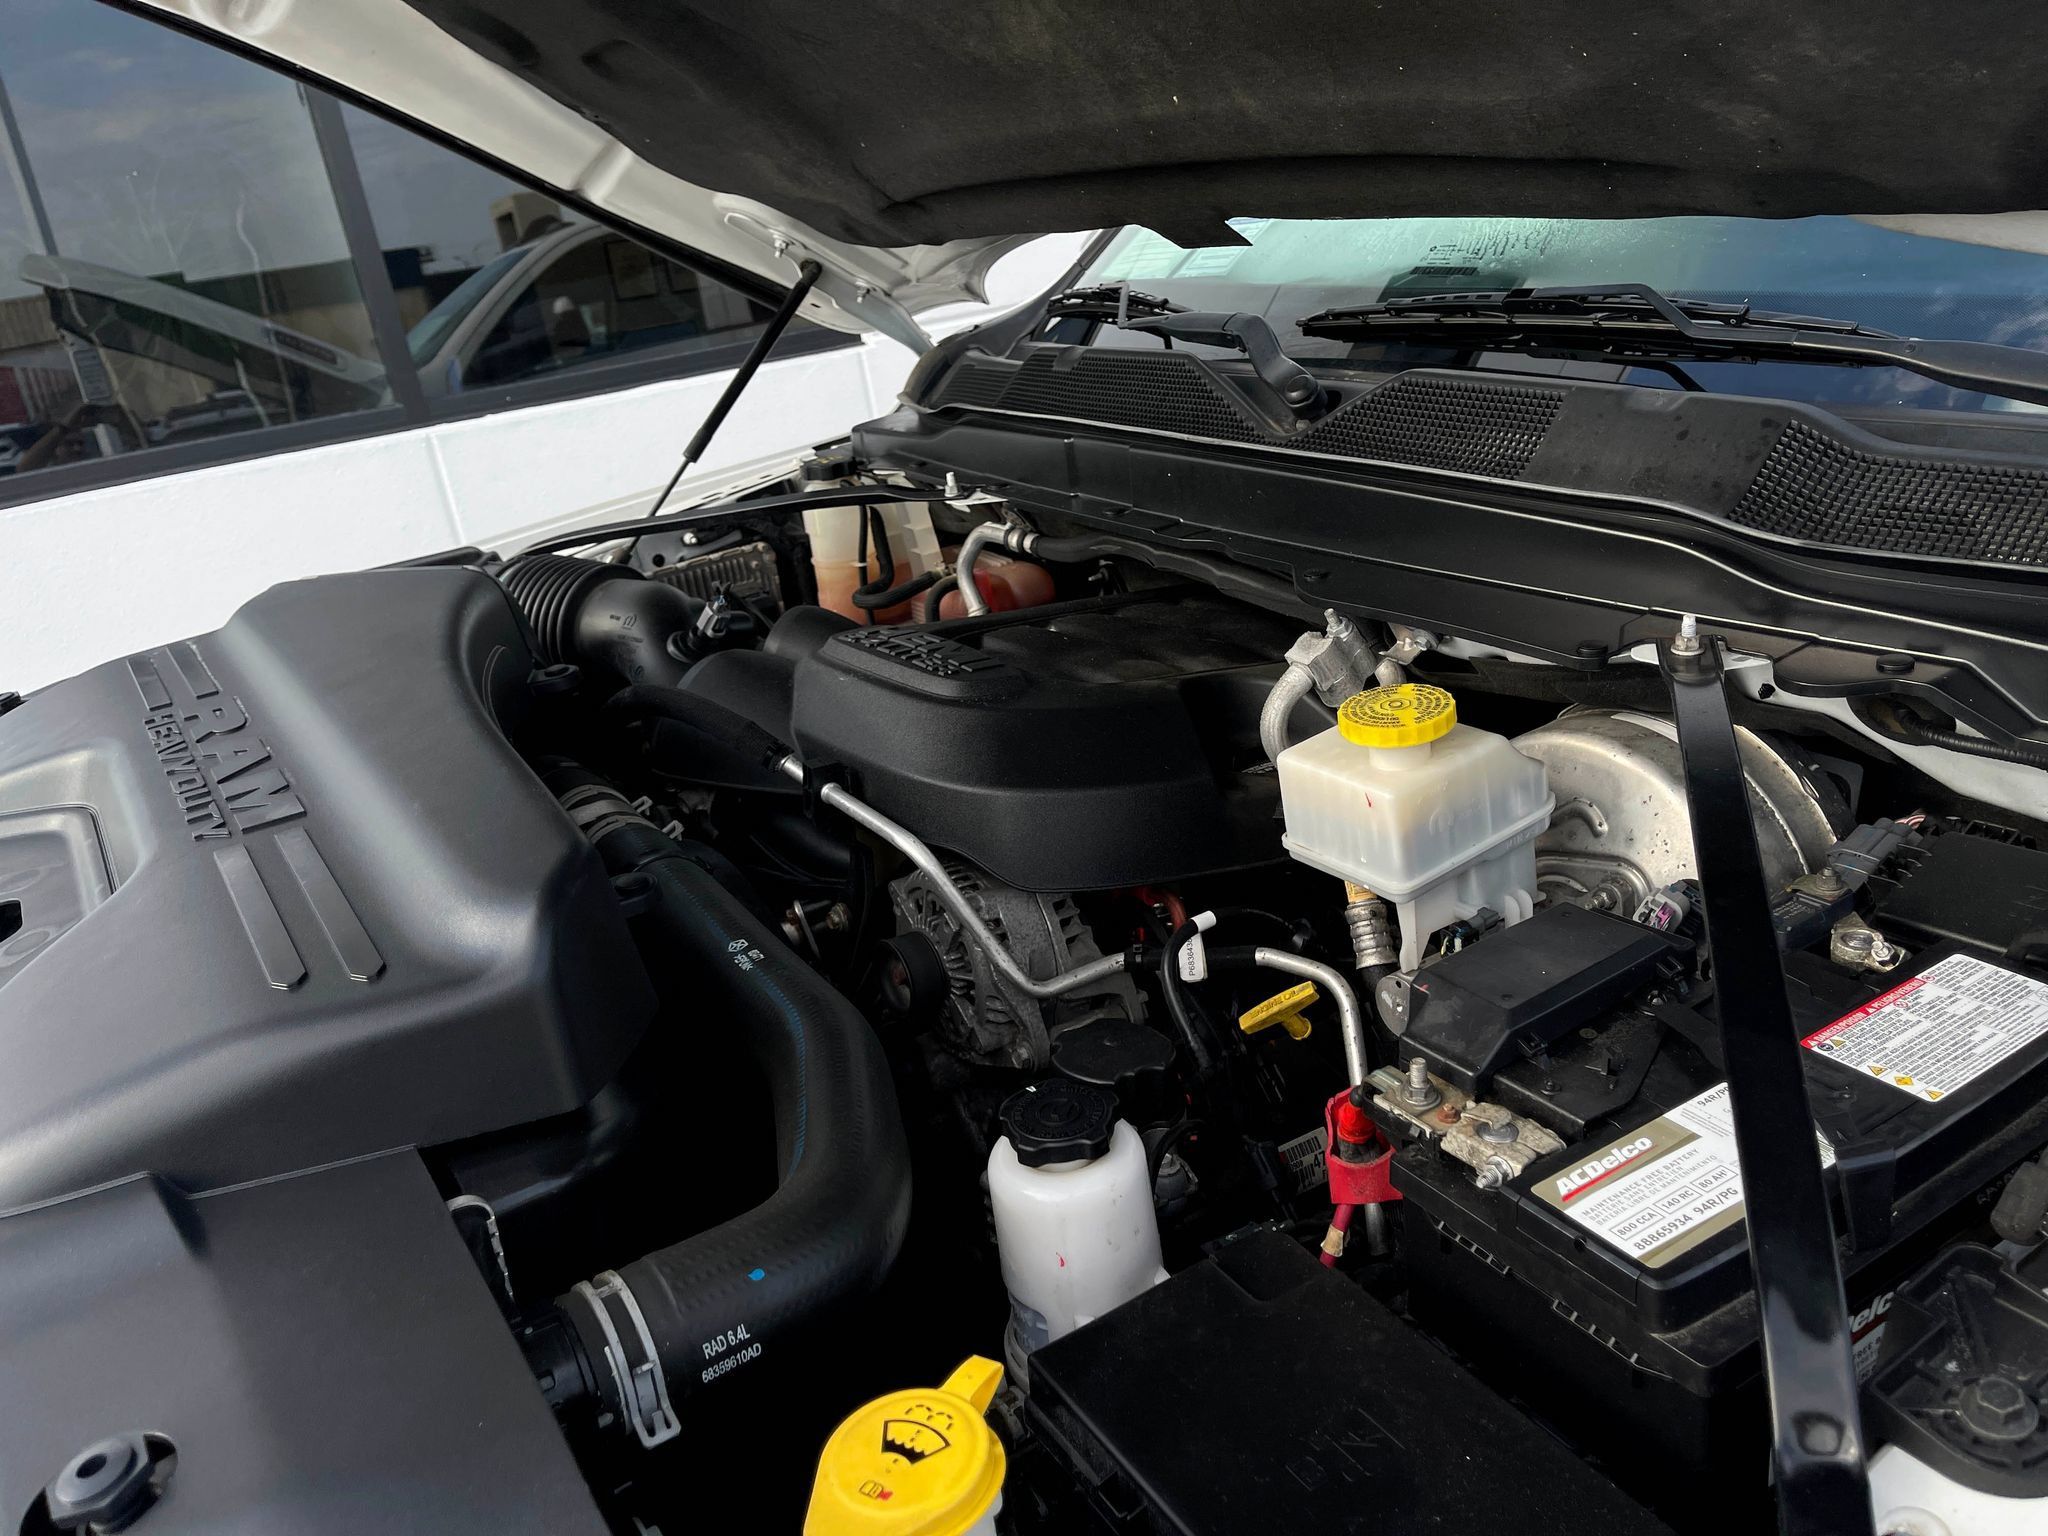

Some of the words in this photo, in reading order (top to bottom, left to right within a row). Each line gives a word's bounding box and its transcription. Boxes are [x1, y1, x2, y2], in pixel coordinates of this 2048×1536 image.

[143, 712, 201, 777] HEAVY
[179, 694, 309, 834] RAM
[168, 771, 234, 842] DUTY
[1249, 998, 1284, 1019] ENGINE
[1284, 989, 1299, 1006] OIL
[1555, 1136, 1653, 1196] ACDelco
[1581, 1181, 1642, 1217] MAINTENANCE
[1641, 1168, 1664, 1183] FREE
[1662, 1148, 1700, 1171] BATTERY
[1627, 1193, 1650, 1208] LIBRE
[1649, 1186, 1661, 1196] DE
[1660, 1154, 1718, 1188] MANTENIMIENTO
[1698, 1179, 1713, 1189] 80
[1588, 1197, 1624, 1222] BATTERIE
[1623, 1186, 1646, 1202] SANS
[1643, 1166, 1685, 1190] ENTRETIEN
[1633, 1213, 1694, 1250] 88865934
[1692, 1187, 1739, 1215] 94R/PG
[1661, 1197, 1681, 1210] 140
[1678, 1190, 1694, 1200] RC
[1616, 1222, 1638, 1236] 800
[1636, 1211, 1657, 1225] CCA
[701, 1342, 762, 1383] 68359610AD
[702, 1334, 728, 1360] RAD
[727, 1323, 751, 1346] 6.4L
